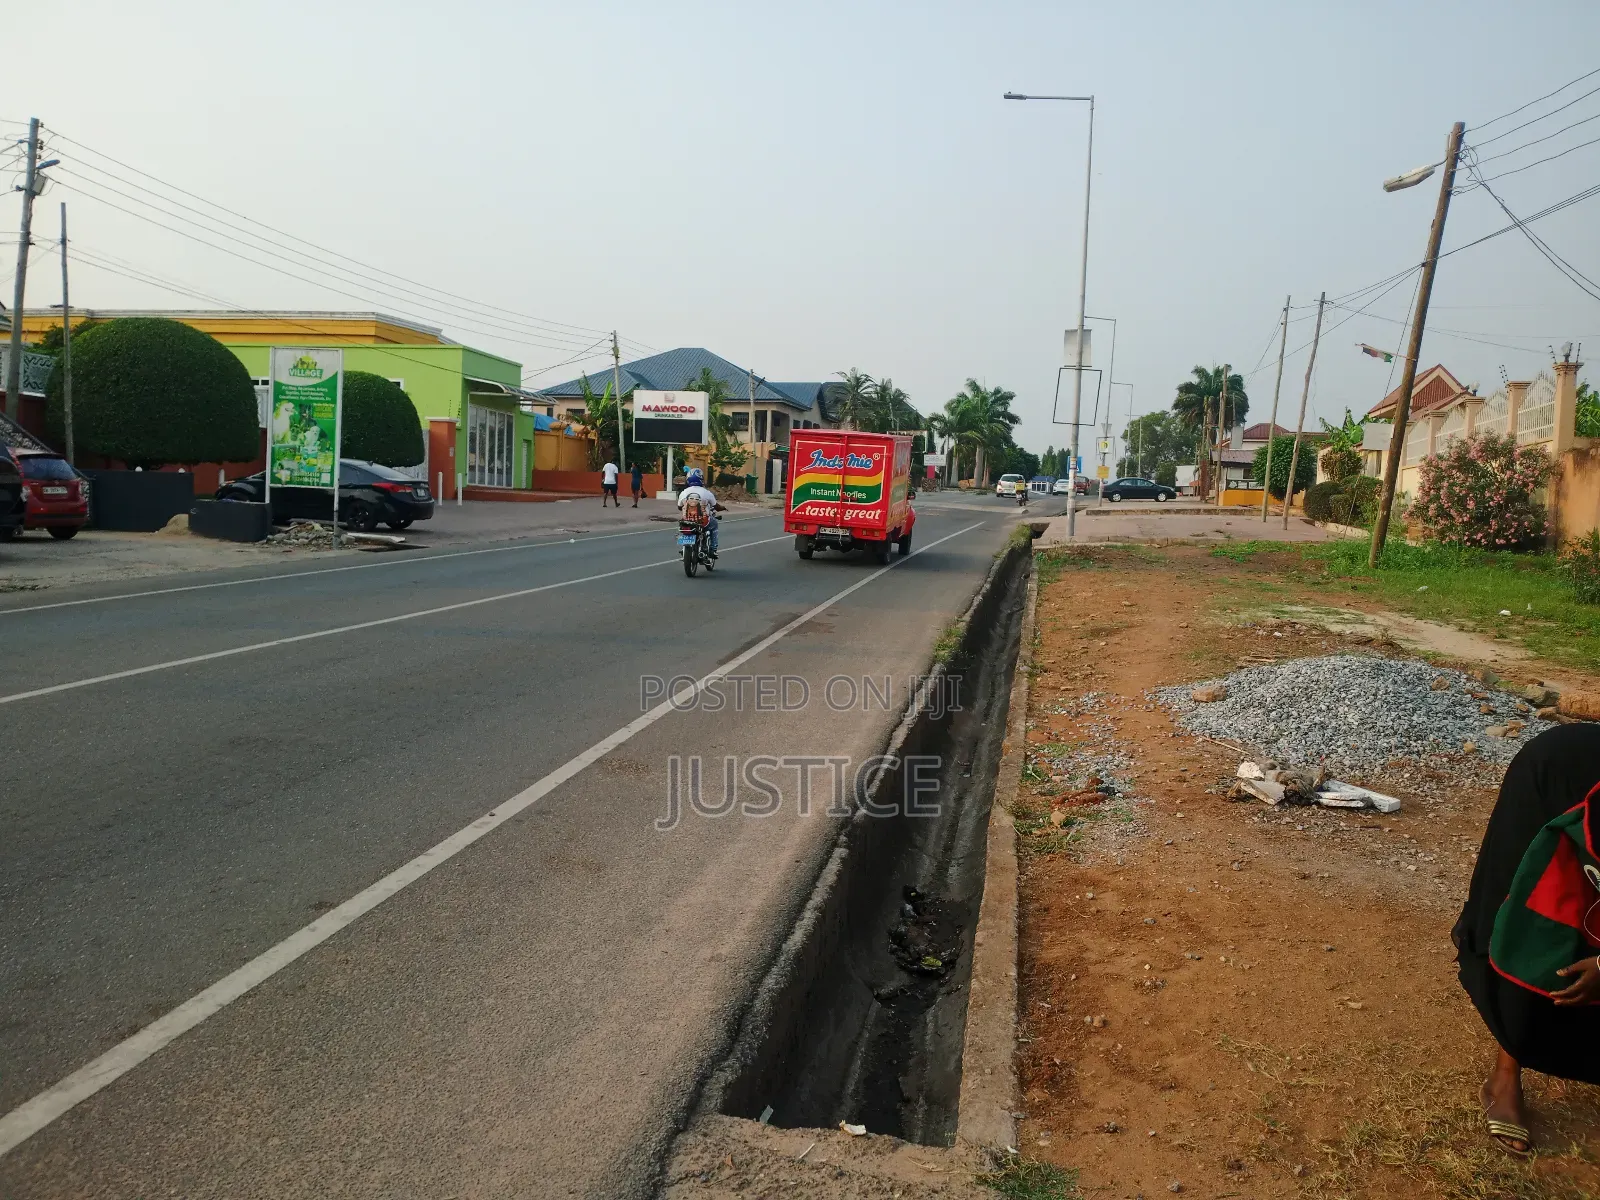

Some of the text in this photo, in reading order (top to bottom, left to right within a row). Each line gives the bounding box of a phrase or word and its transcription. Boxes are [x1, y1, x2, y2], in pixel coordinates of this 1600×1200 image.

[289, 368, 322, 377] VILLAGE
[642, 404, 696, 413] MAWOOD
[810, 487, 835, 497] Instant
[843, 508, 881, 520] great
